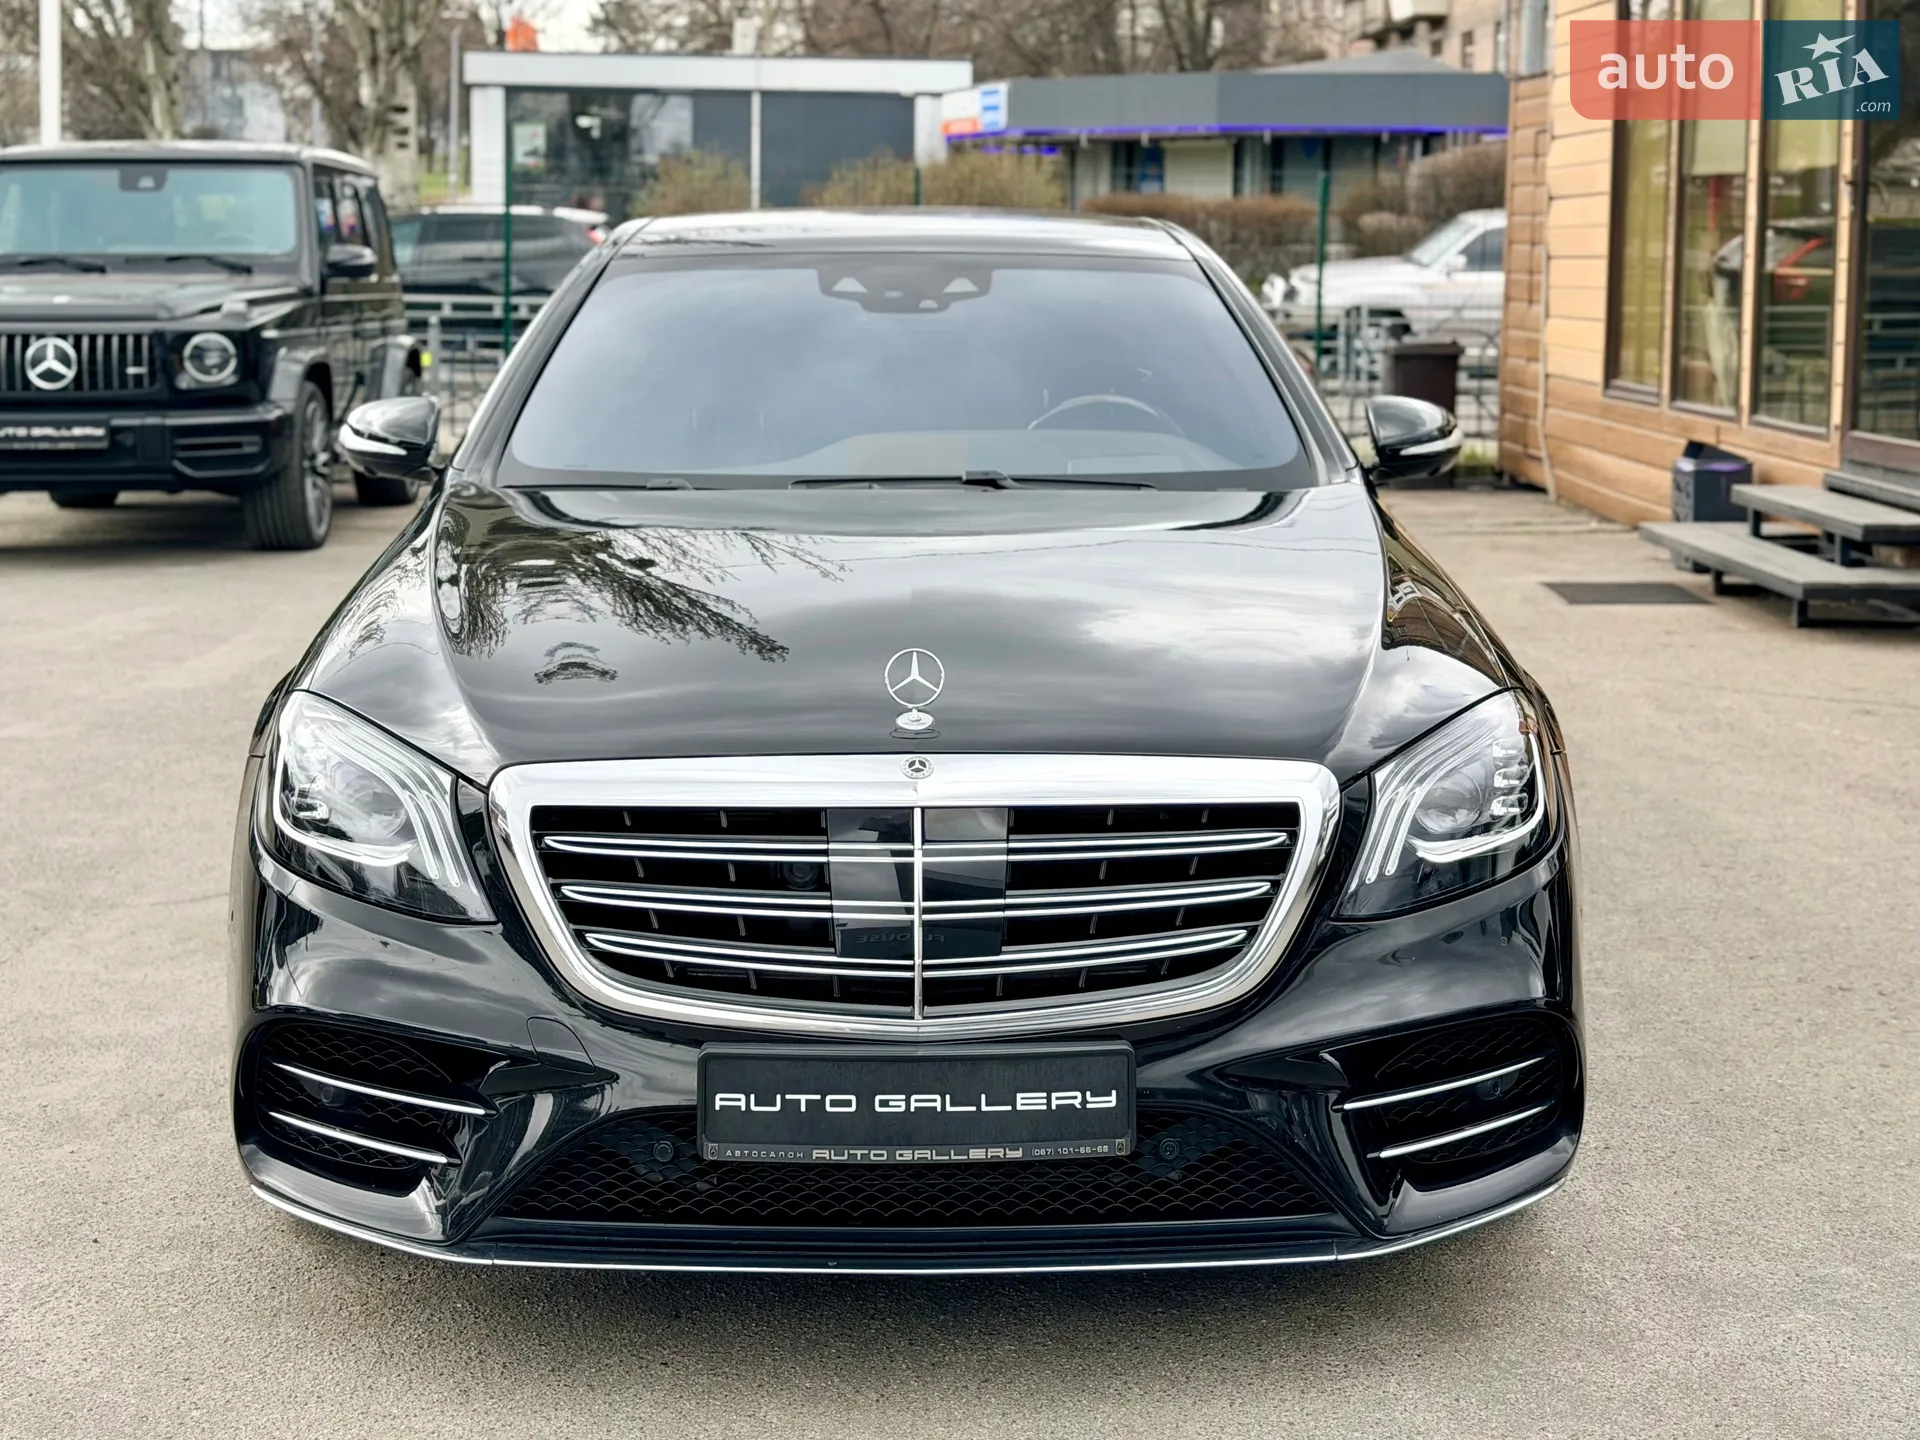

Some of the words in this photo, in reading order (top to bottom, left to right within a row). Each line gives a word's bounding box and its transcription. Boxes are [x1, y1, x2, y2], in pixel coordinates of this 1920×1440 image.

[714, 1092, 857, 1113] AUTO
[874, 1089, 1117, 1113] GALLERY
[725, 1150, 804, 1159] АВТОСАЛОН
[812, 1149, 888, 1161] AUTO
[895, 1147, 1023, 1161] GALLERY
